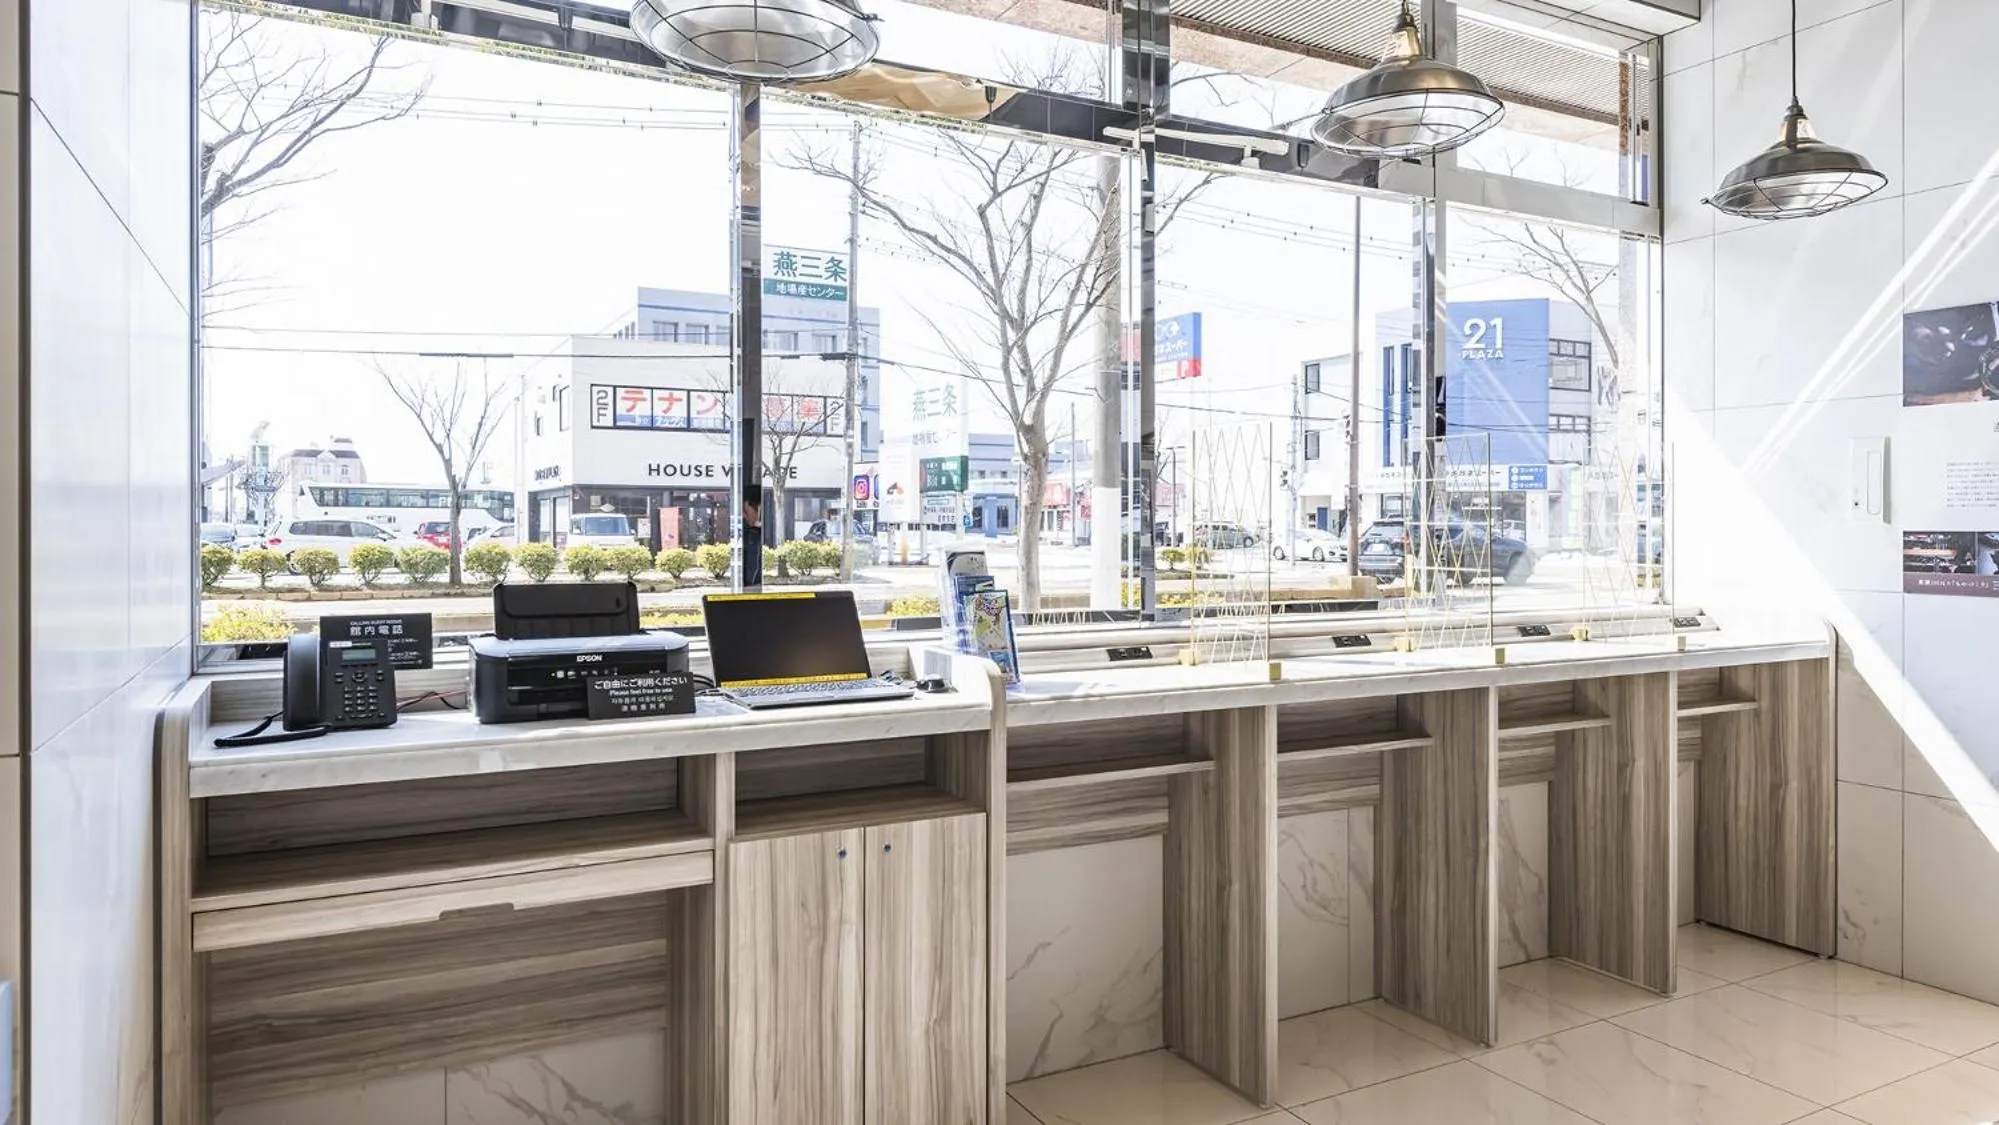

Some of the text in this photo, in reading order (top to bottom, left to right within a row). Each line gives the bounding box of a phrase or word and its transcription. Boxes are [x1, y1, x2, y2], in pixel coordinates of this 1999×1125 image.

[773, 251, 847, 282] 燕三条
[776, 281, 845, 298] 地場産センター
[1463, 316, 1504, 350] 21
[1462, 350, 1504, 360] PLAZA
[596, 389, 609, 424] 2F
[912, 382, 958, 422] 燕三条
[648, 463, 714, 478] HOUSE
[350, 624, 403, 637] 館内電話
[594, 677, 688, 690] ご自由にご利用ください
